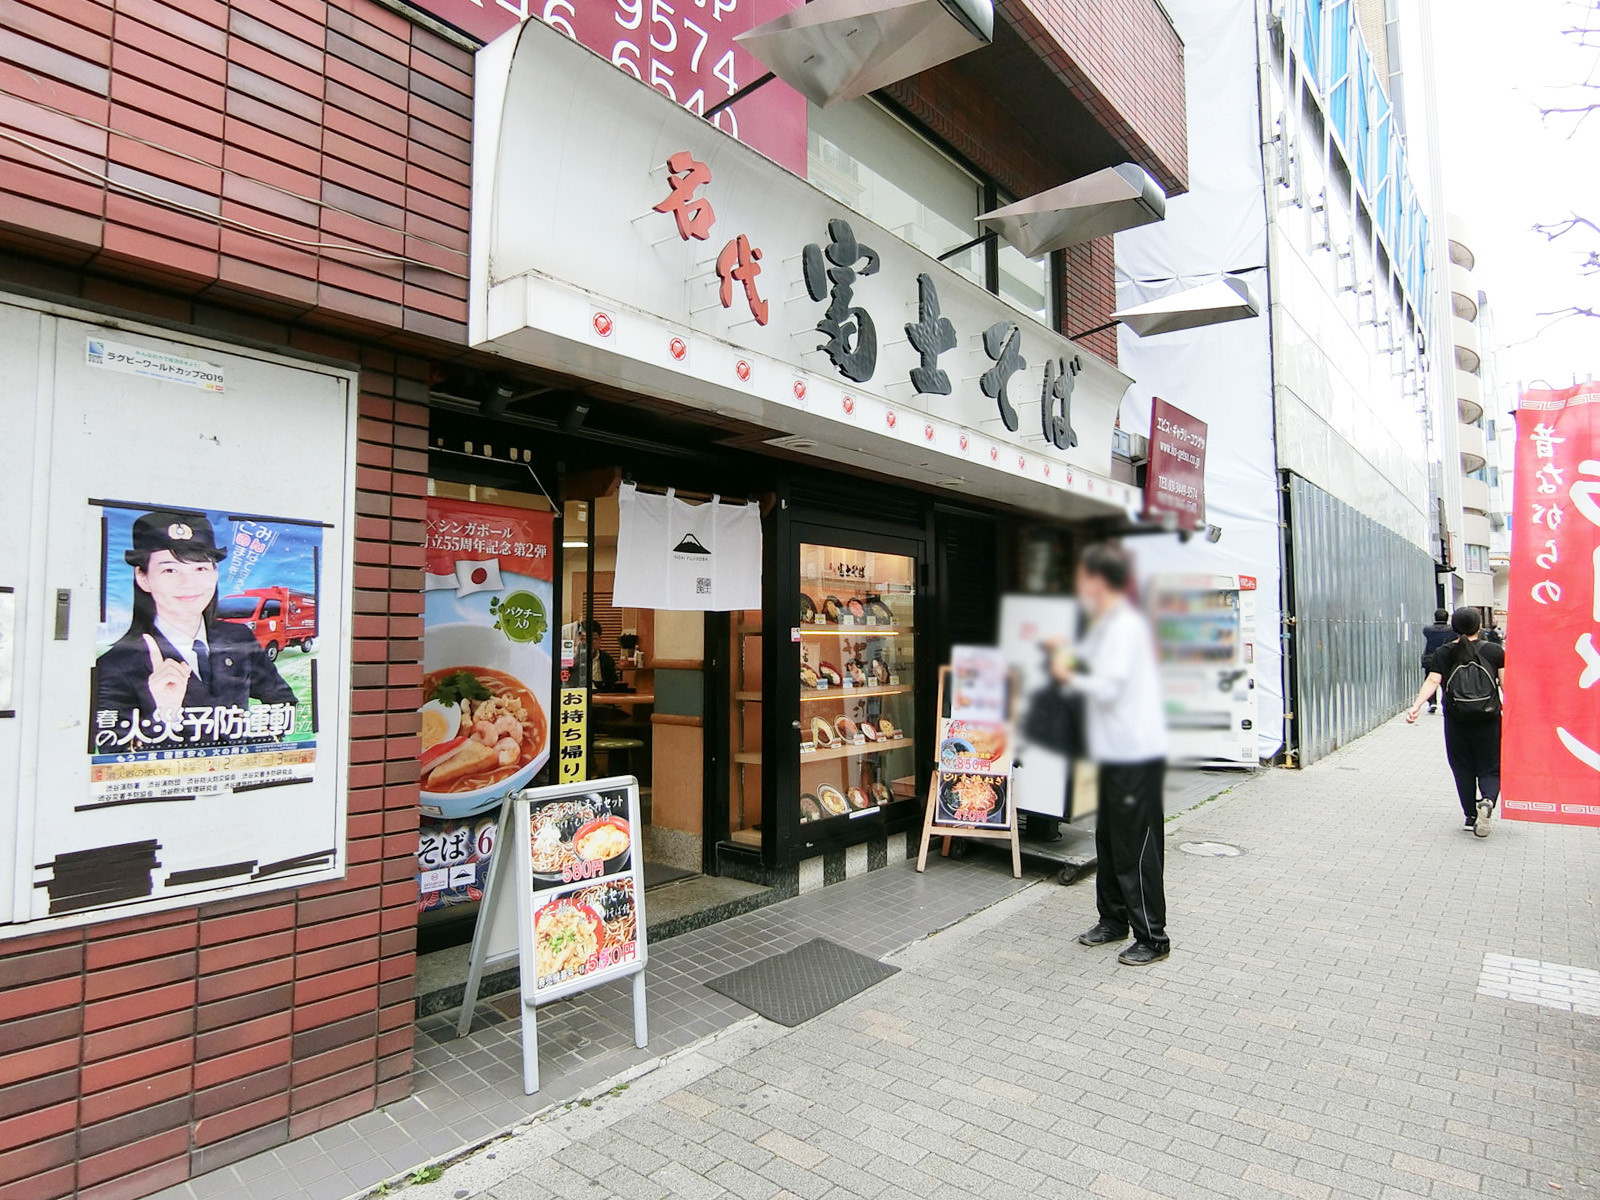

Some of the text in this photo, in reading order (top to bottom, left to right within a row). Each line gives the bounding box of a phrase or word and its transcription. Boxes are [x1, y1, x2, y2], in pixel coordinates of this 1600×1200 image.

[652, 150, 1083, 450] 名代 富士そば
[107, 351, 224, 383] ラグビーワールドカップ2019
[1530, 423, 1567, 605] 昔ながらの
[513, 541, 547, 559] 第2弾
[505, 607, 542, 619] パクチー
[514, 618, 530, 630] 入り
[117, 702, 296, 745] 火災予防運動
[561, 692, 584, 784] お持ち帰り
[957, 757, 991, 772] 850円
[418, 831, 467, 864] そば
[562, 858, 605, 883] 580円
